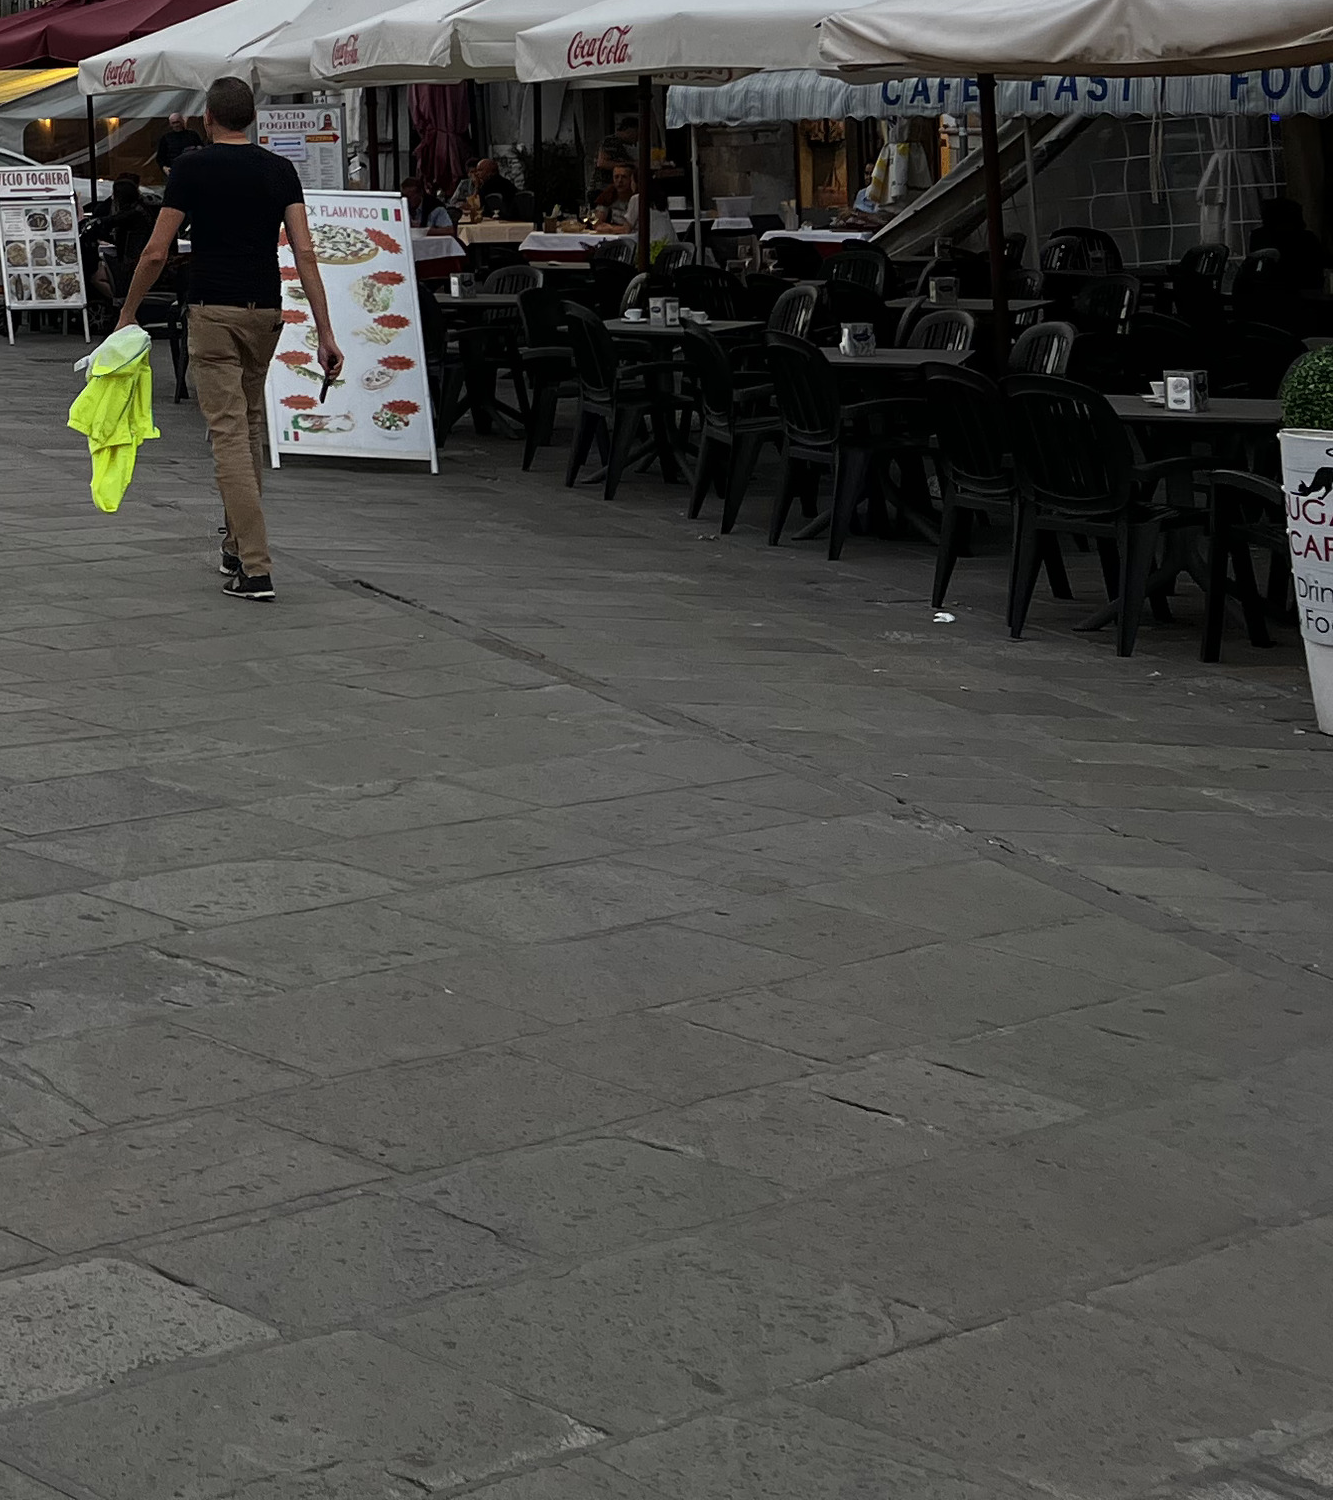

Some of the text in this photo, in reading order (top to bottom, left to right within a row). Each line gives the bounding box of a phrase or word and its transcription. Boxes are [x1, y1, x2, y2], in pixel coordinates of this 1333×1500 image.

[567, 25, 633, 70] Coca-Cola
[259, 121, 316, 130] FOGHERO
[268, 111, 305, 120] VECIO
[26, 171, 70, 186] FOGHERO
[1286, 496, 1333, 526] UG
[1306, 608, 1333, 634] Fo
